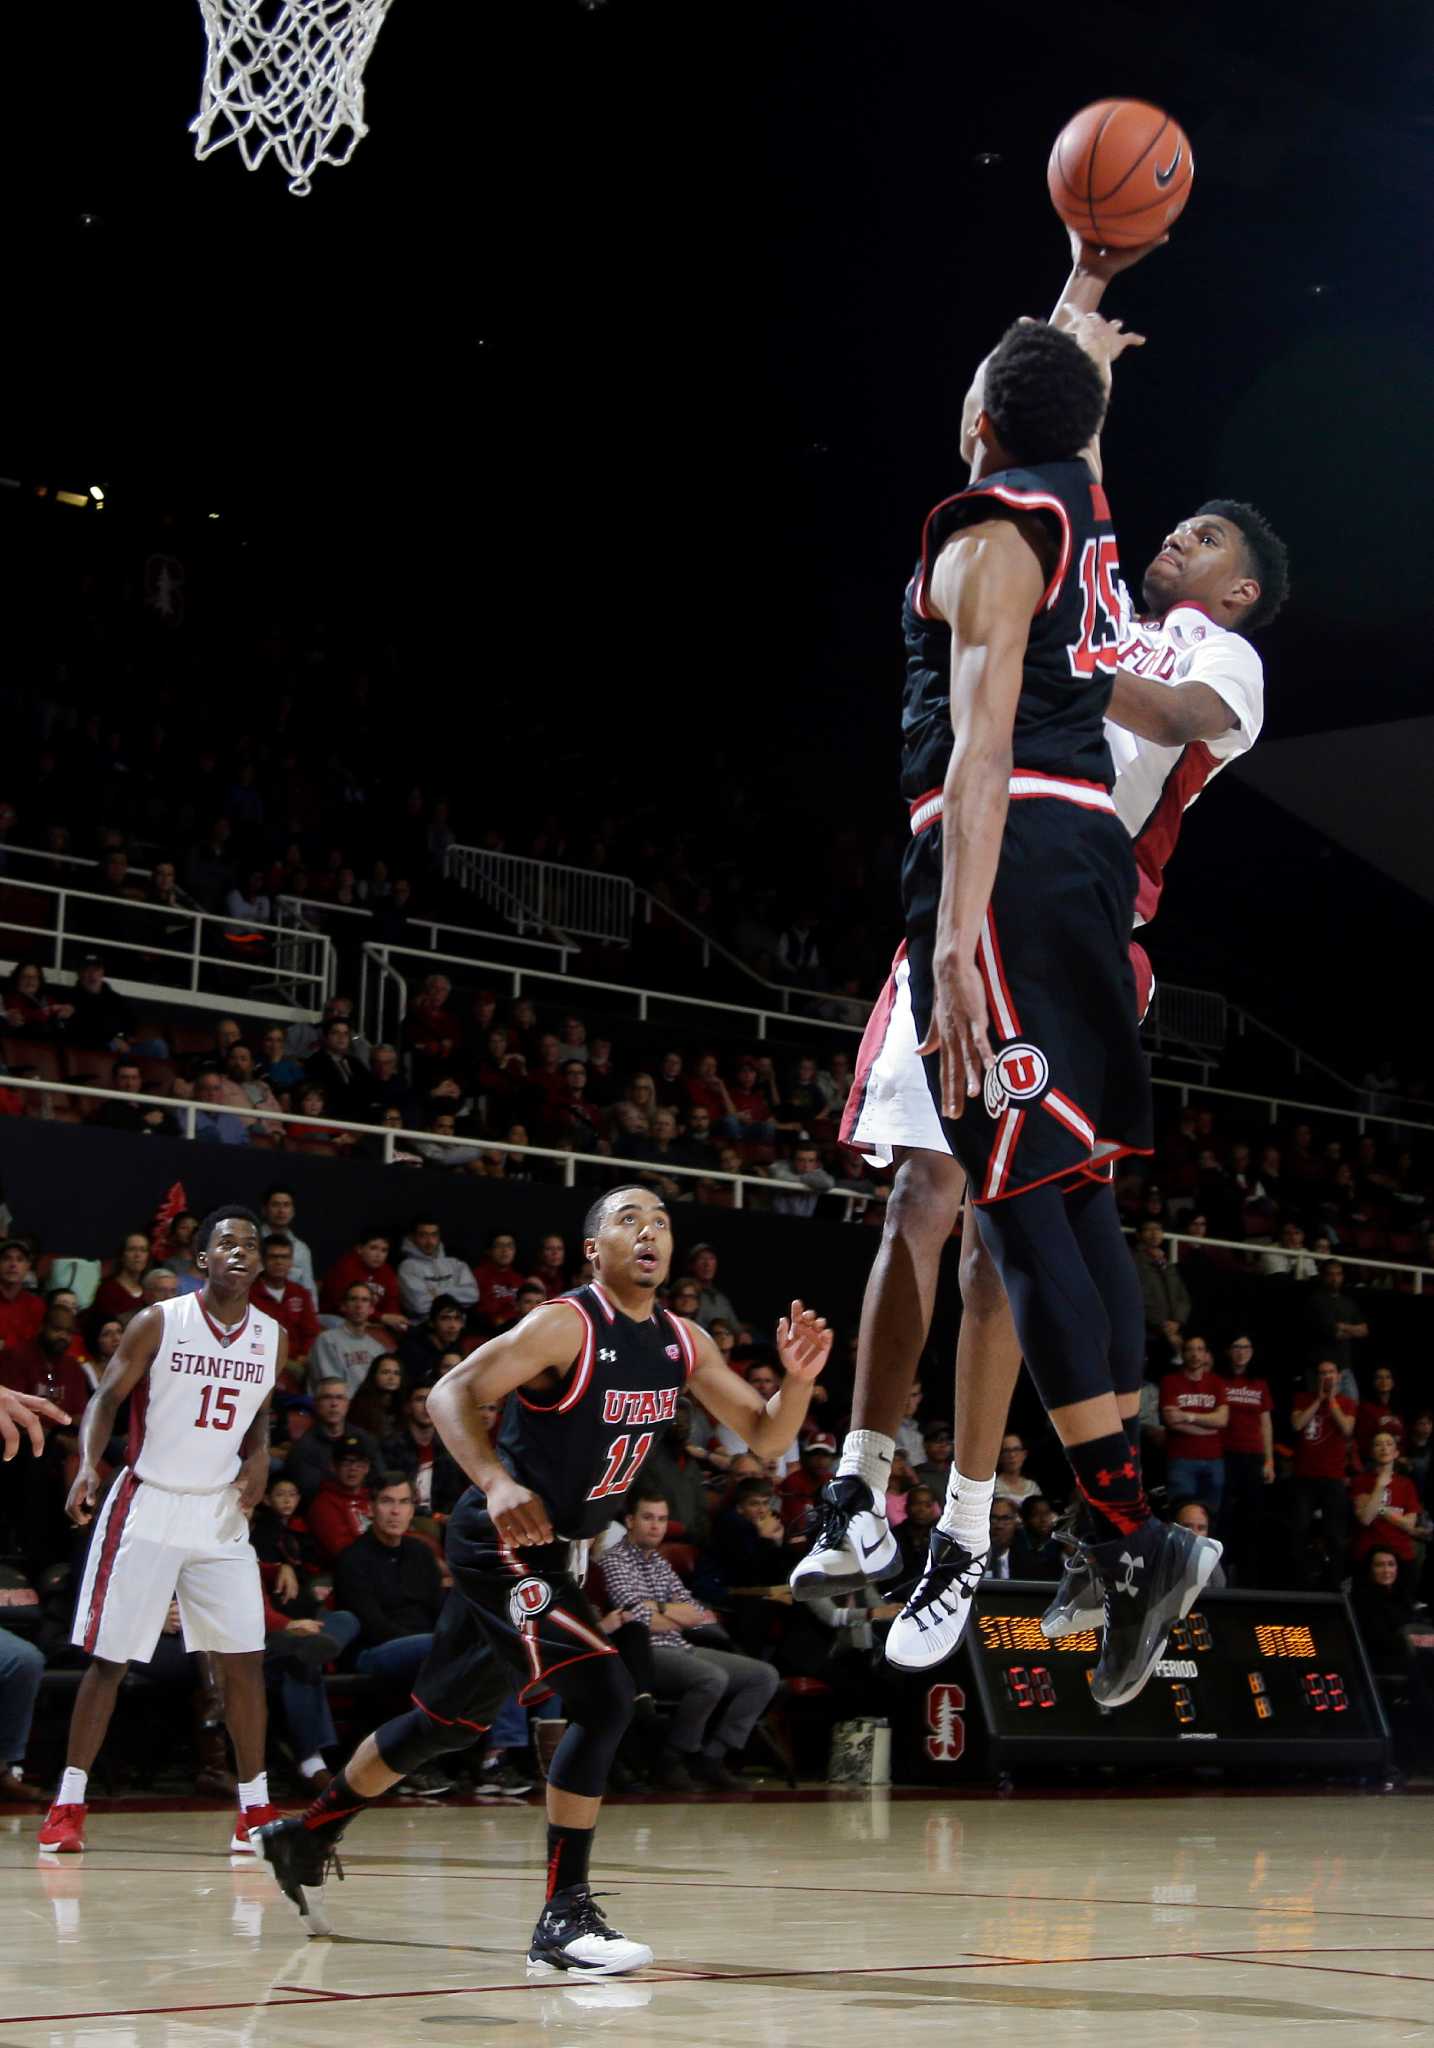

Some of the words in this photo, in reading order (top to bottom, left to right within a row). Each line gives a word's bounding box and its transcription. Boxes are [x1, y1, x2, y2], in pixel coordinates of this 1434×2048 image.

[1066, 535, 1120, 679] 15
[1002, 1054, 1037, 1091] U
[170, 1352, 265, 1384] STANFORD
[194, 1384, 241, 1431] 15
[602, 1387, 679, 1425] UTAH
[585, 1432, 655, 1501] 11
[518, 1583, 543, 1610] U
[1155, 1659, 1199, 1678] PERIOD
